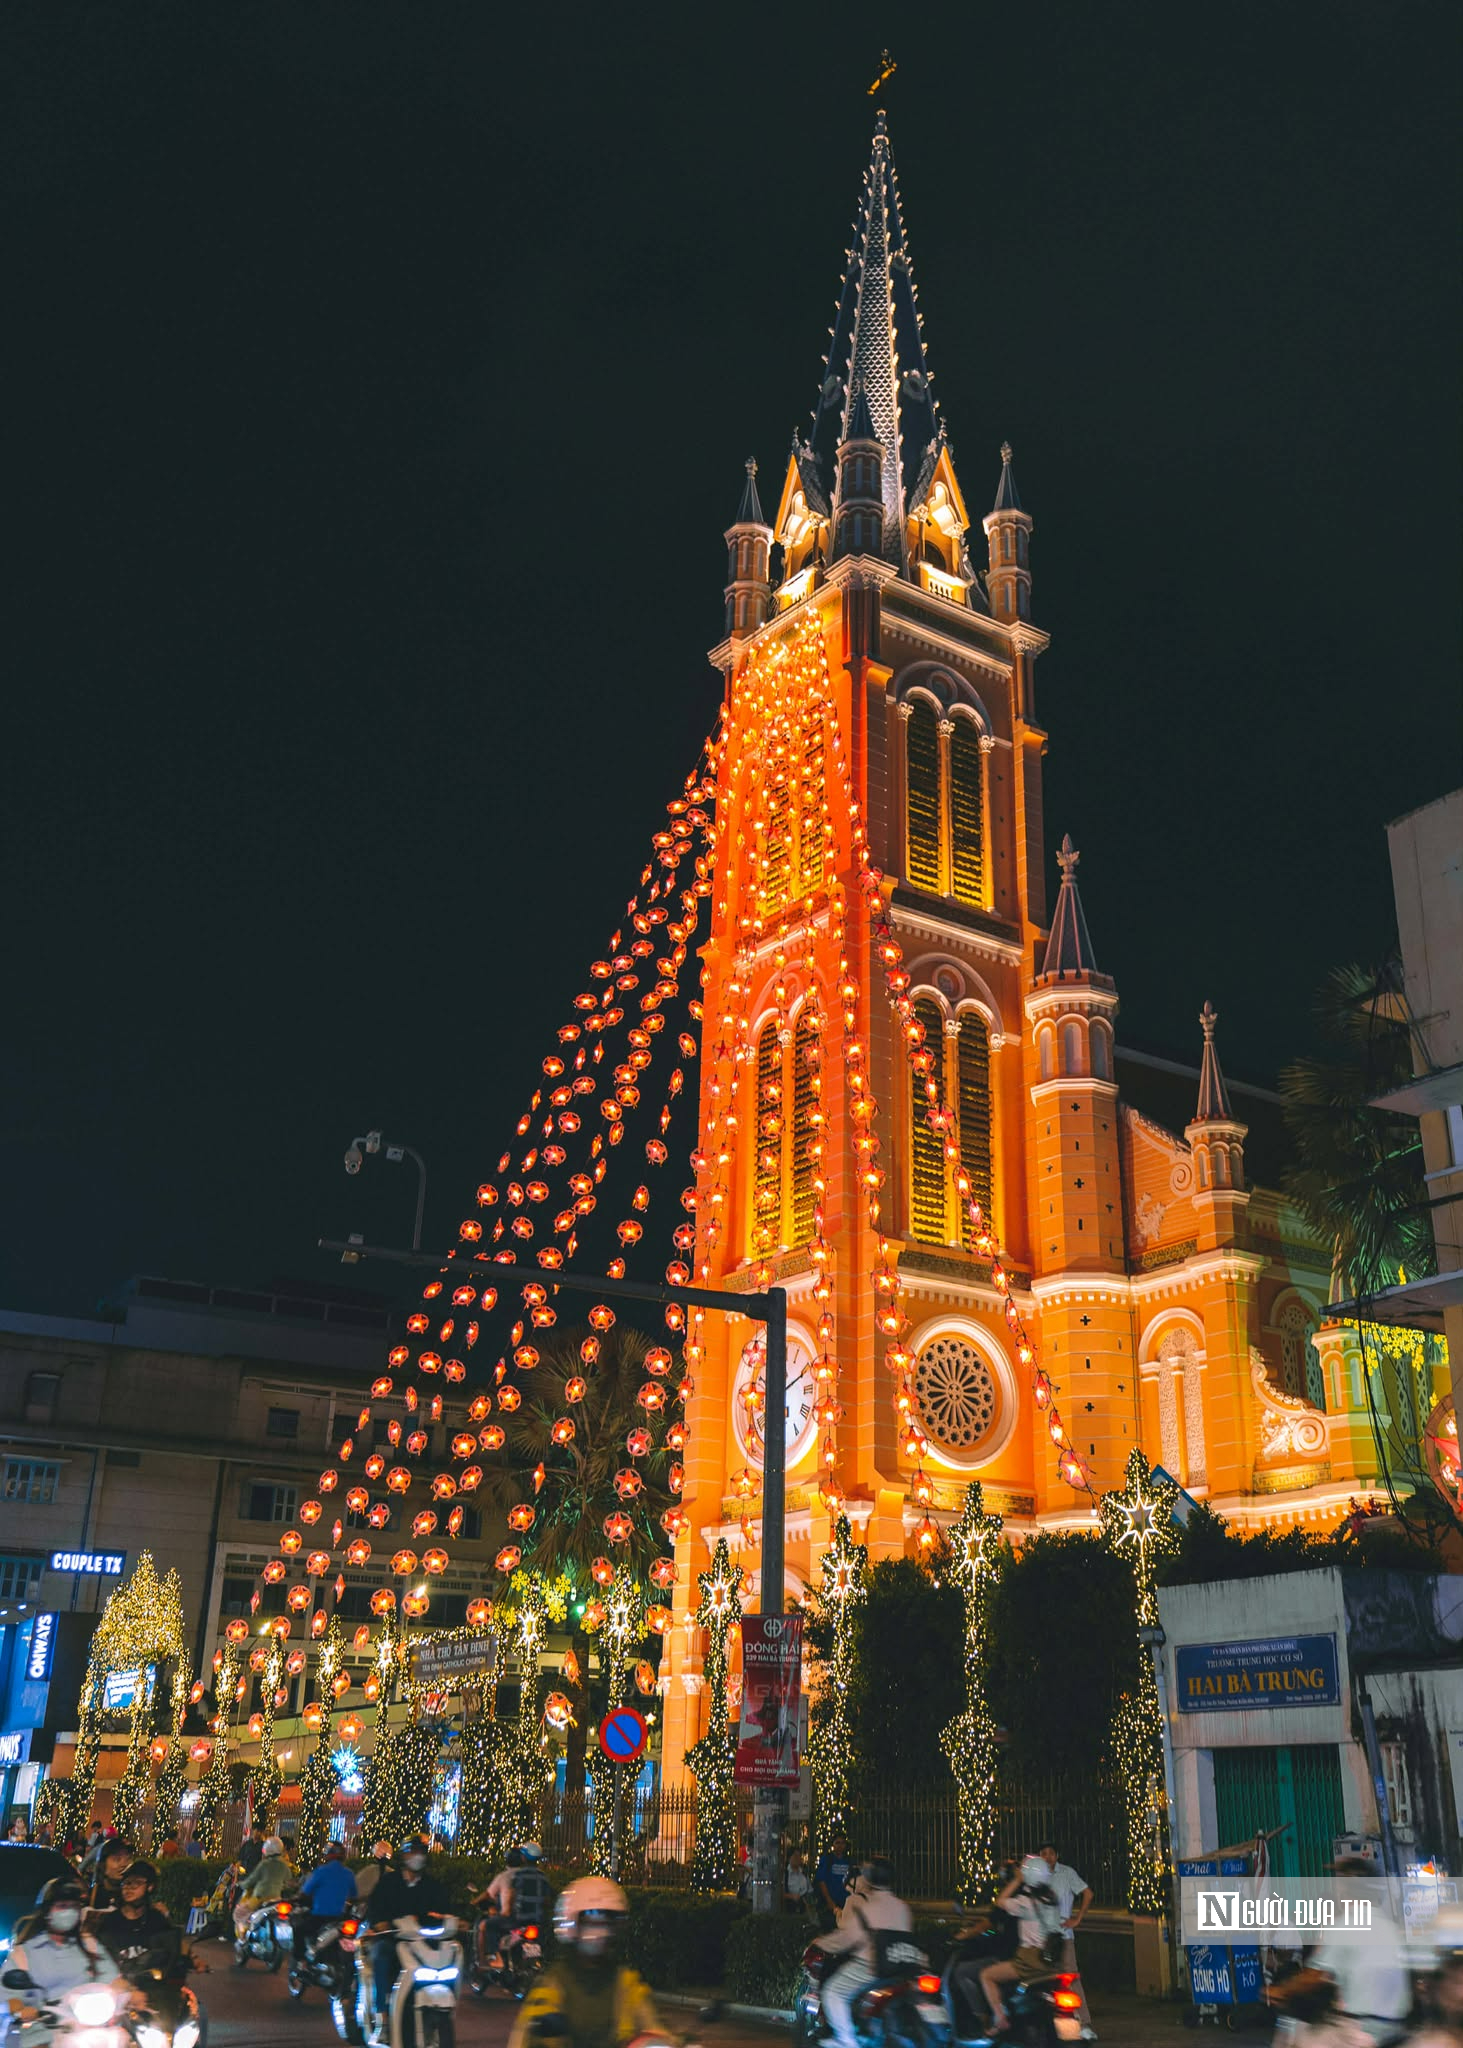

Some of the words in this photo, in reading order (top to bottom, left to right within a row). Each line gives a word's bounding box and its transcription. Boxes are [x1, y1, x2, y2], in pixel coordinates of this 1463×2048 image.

[53, 1553, 103, 1572] COUPLE
[104, 1556, 123, 1574] TX
[29, 1614, 53, 1679] ONWAYS
[419, 1645, 436, 1661] NHÀ
[1236, 1656, 1262, 1667] TRUNG
[1263, 1655, 1279, 1667] HỌC
[1187, 1676, 1223, 1696] HAI
[1226, 1669, 1253, 1694] BÀ
[1254, 1667, 1326, 1692] TRƯNG
